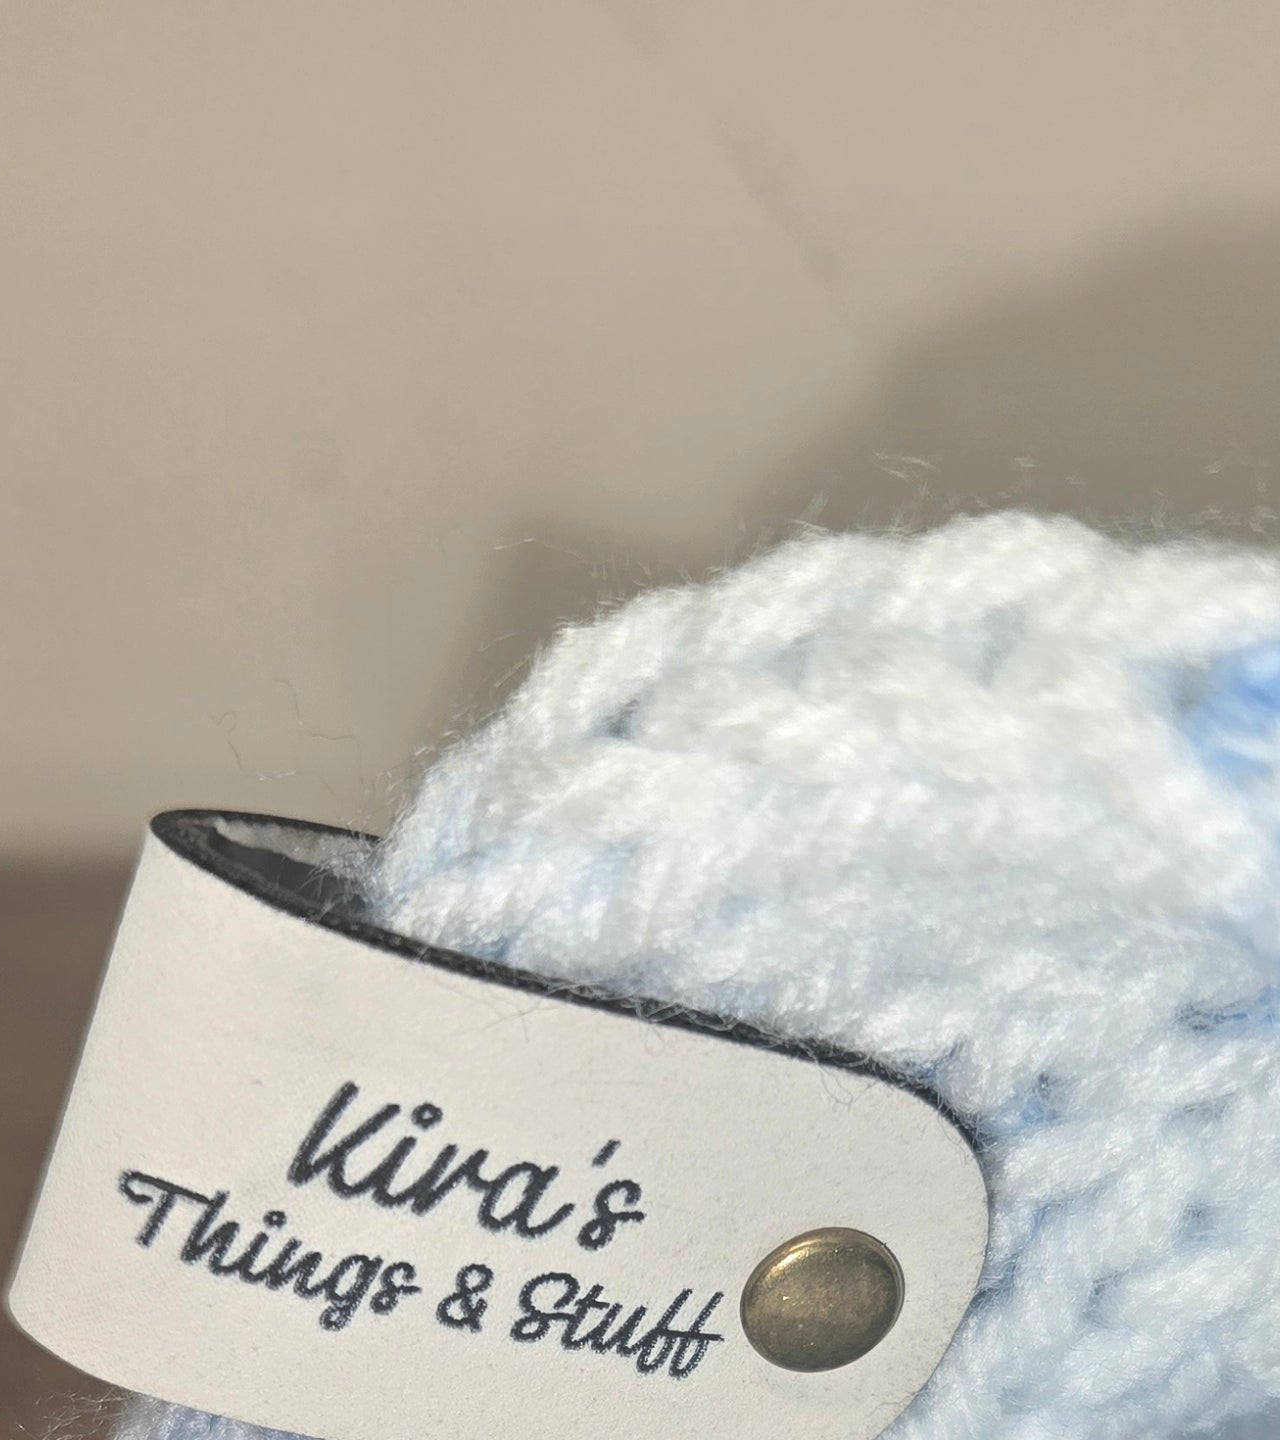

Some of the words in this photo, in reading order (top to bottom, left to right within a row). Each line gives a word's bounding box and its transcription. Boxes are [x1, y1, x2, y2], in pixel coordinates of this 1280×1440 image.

[286, 1080, 648, 1252] Kira's
[117, 1168, 423, 1332] Things
[435, 1262, 495, 1334] &
[509, 1271, 725, 1382] Stuff
